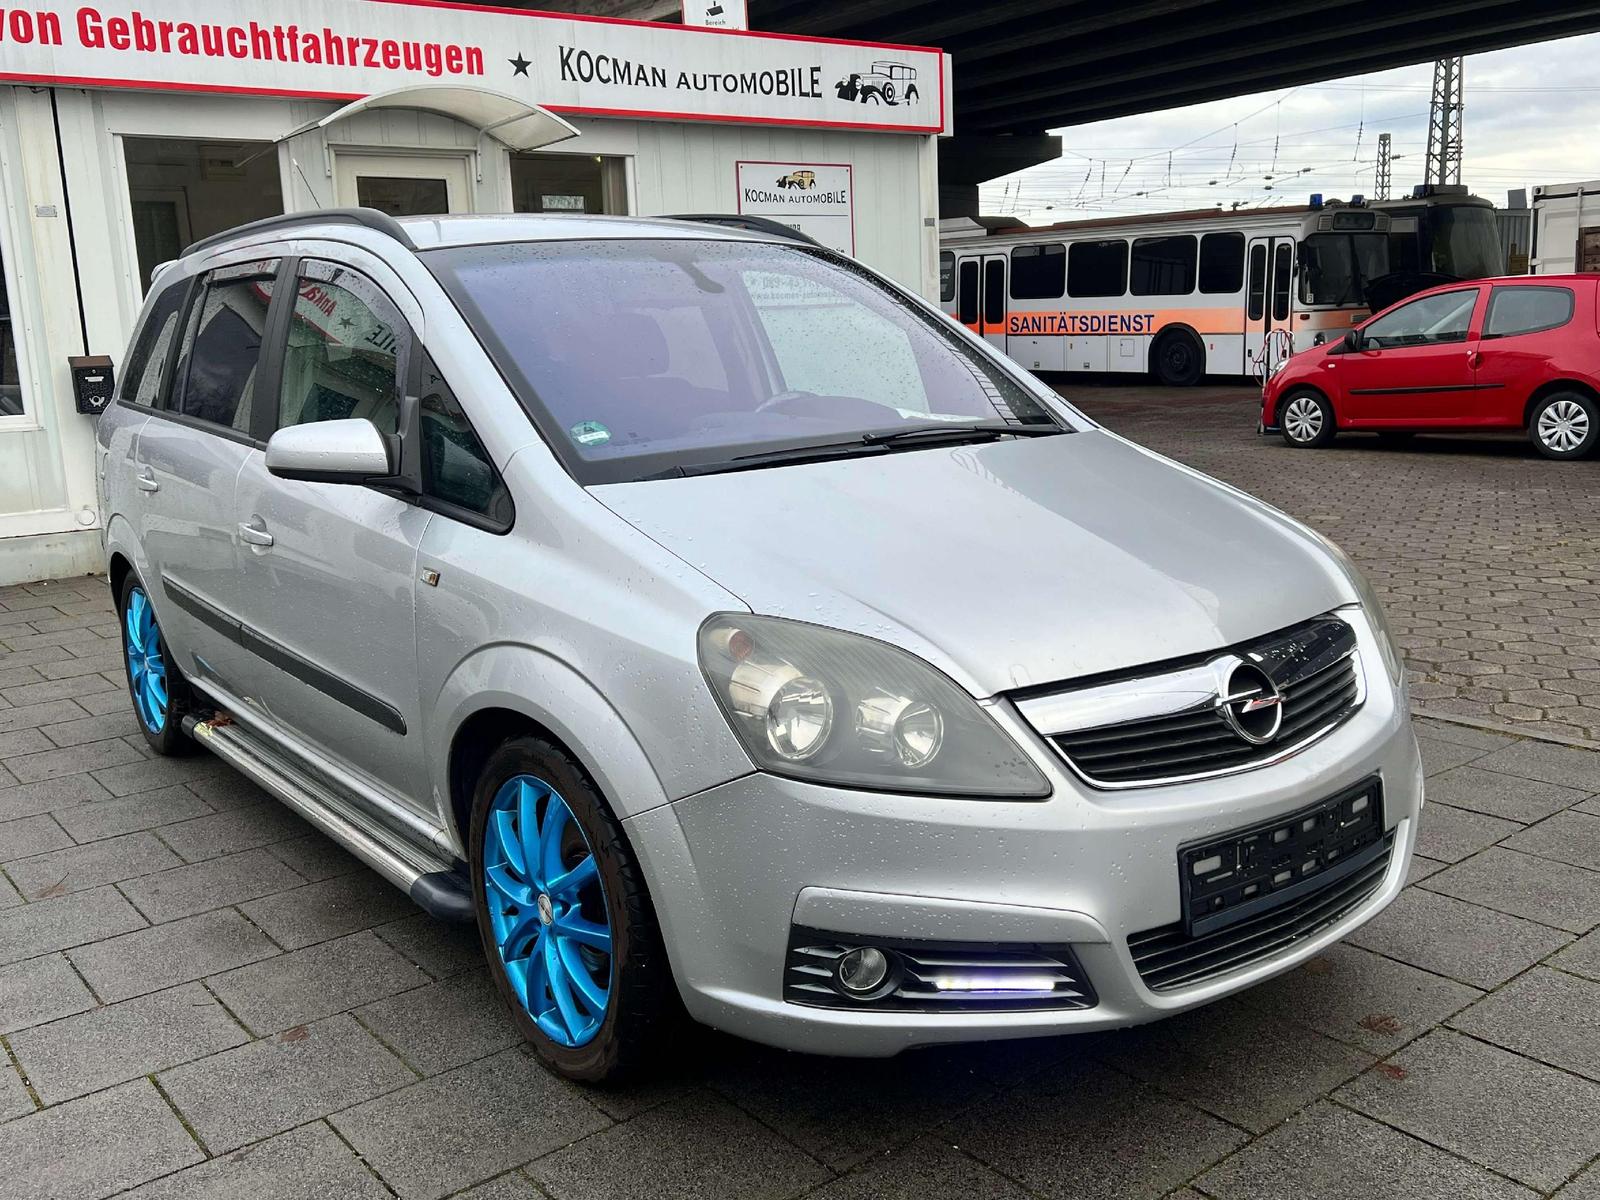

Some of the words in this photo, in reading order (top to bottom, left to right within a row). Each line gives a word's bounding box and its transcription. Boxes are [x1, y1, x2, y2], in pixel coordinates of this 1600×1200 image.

[0, 9, 62, 45] on
[77, 7, 484, 76] Gebrauchtfahrzeugen
[559, 45, 667, 88] KOCMAN
[676, 66, 823, 98] AUTOMOBILE
[744, 188, 785, 203] KOCMAN
[788, 190, 847, 204] AUTOMOBILE
[1010, 312, 1155, 333] SANITÄTSDIENST
